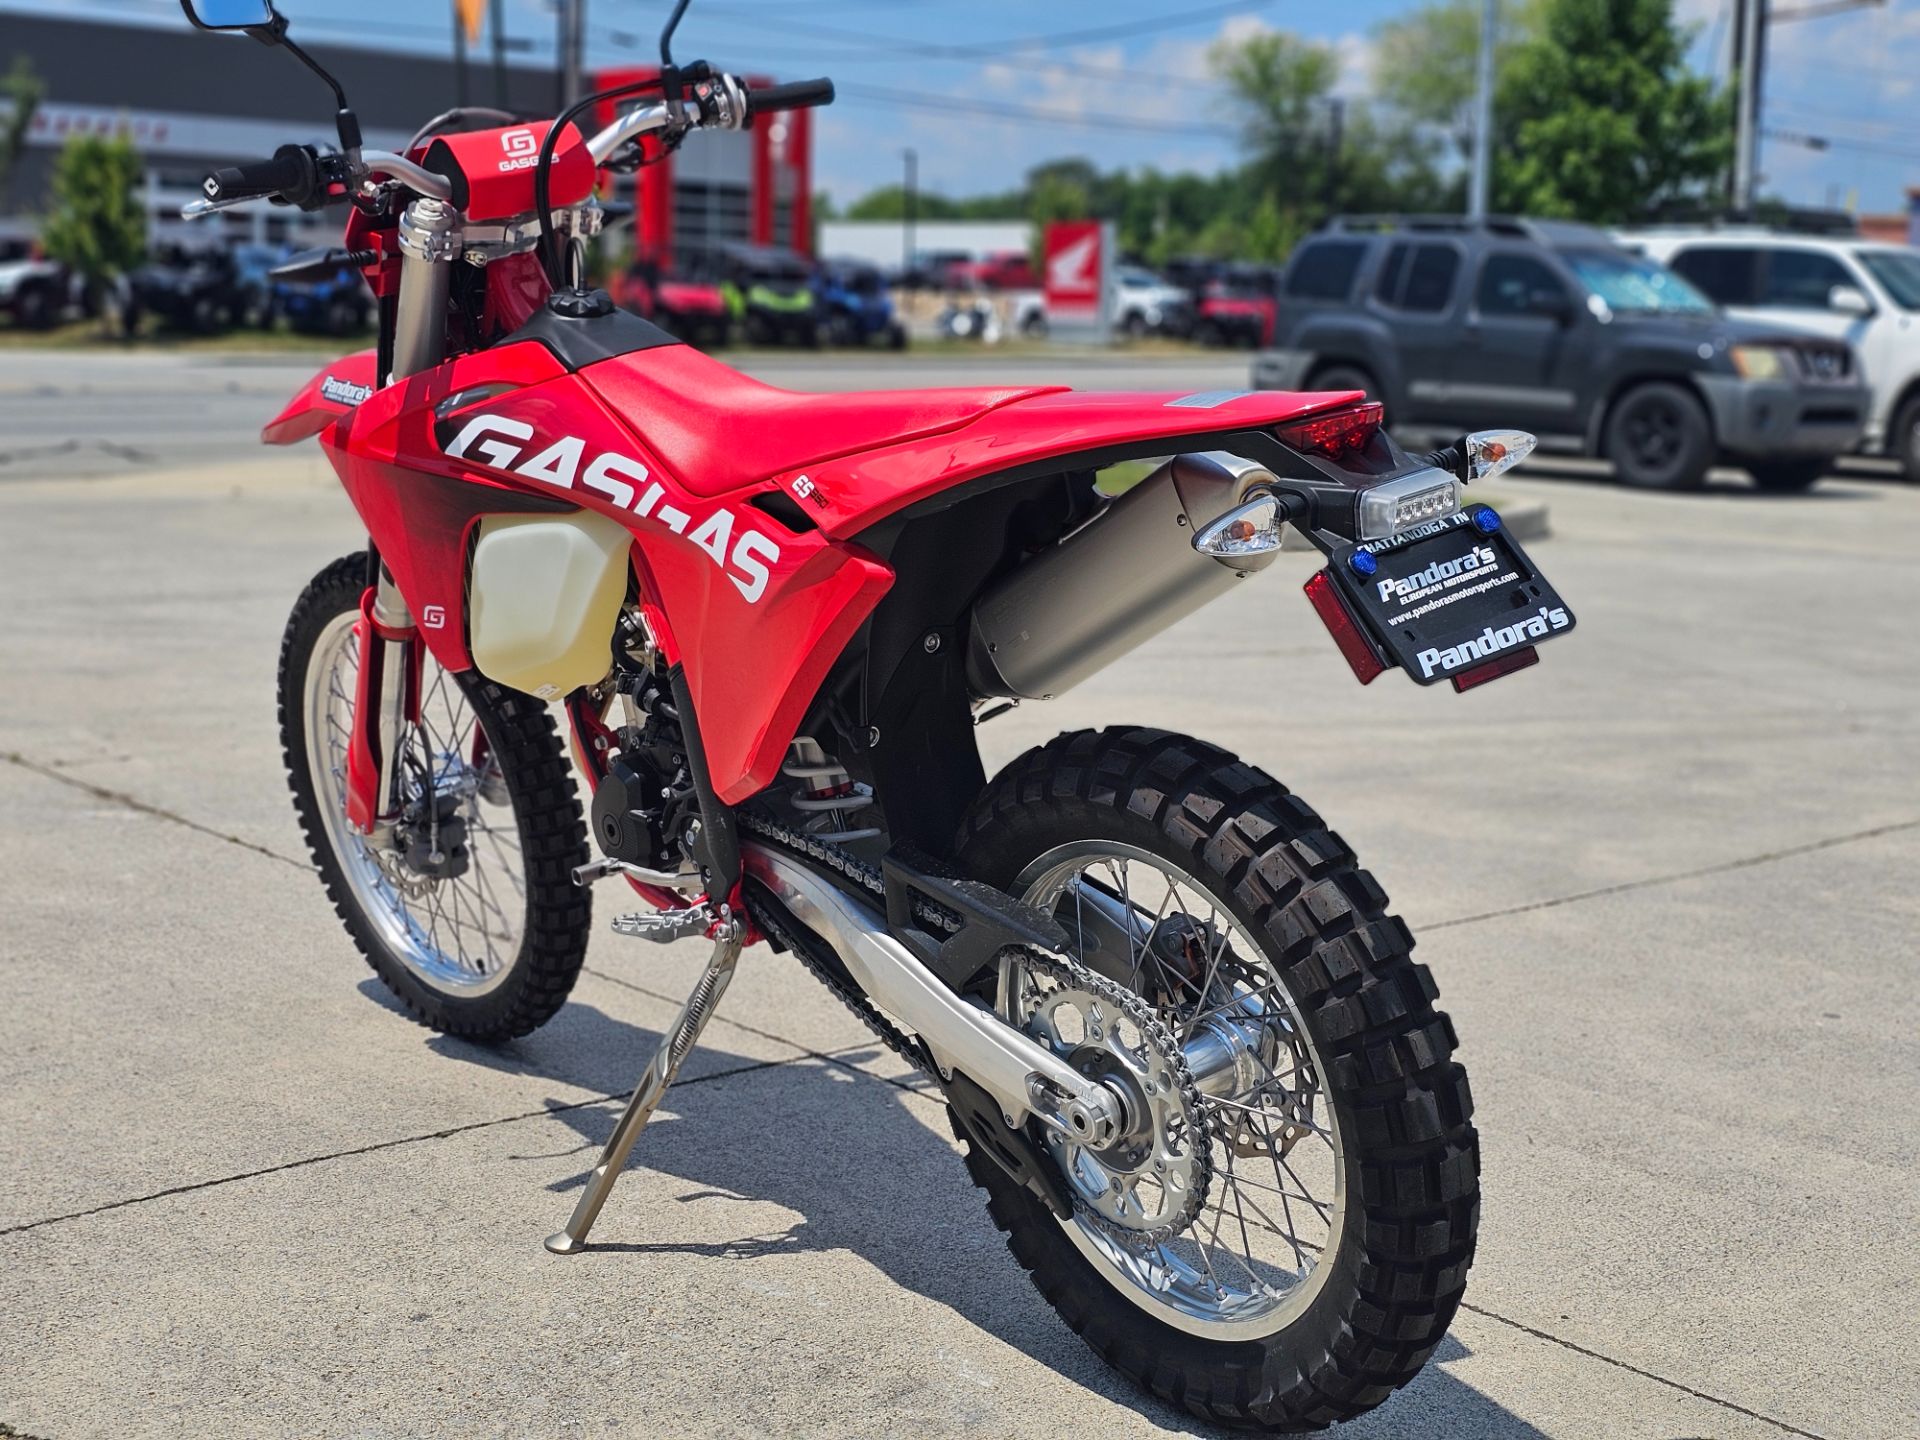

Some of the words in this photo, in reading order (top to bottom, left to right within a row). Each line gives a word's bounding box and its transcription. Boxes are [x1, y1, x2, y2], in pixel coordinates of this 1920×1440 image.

[498, 153, 560, 172] GASGS
[1451, 511, 1470, 525] TN
[1376, 545, 1496, 603] Pandora's
[1387, 570, 1519, 627] www.pandorasmotorsports.com
[1399, 582, 1443, 606] EUROPEAN
[1443, 562, 1499, 588] MOTORSPORTS
[1416, 606, 1569, 679] Pandora's
